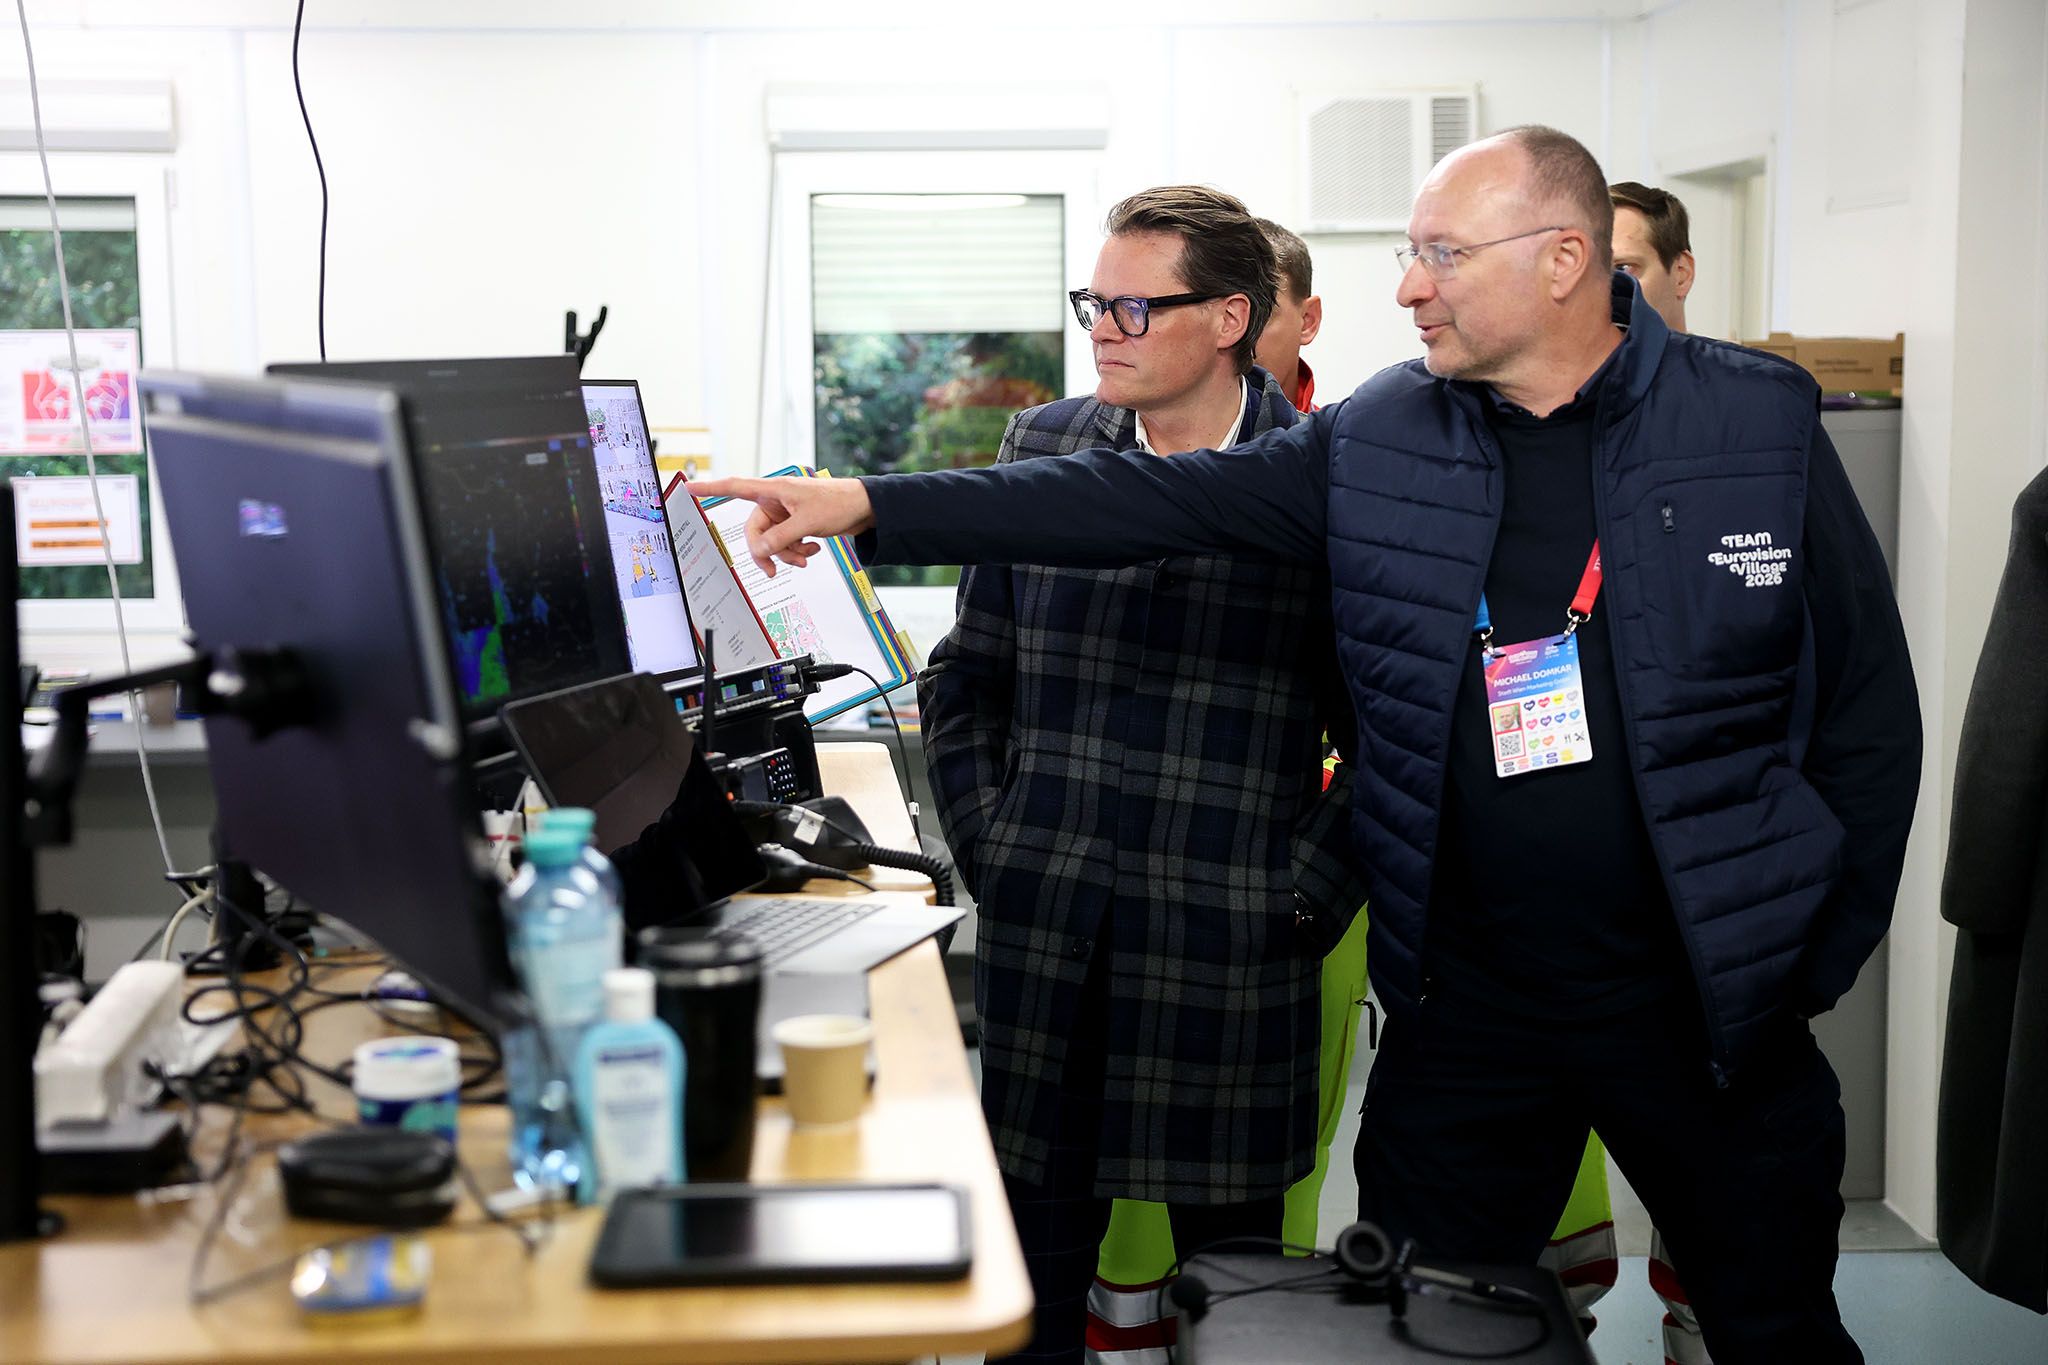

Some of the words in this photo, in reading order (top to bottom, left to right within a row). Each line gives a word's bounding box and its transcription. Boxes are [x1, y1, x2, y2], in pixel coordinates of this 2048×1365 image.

[1721, 532, 1772, 548] TEAM
[1708, 546, 1792, 566] Eurovision
[1729, 561, 1787, 576] Village
[1745, 572, 1783, 587] 2026
[1493, 673, 1533, 688] MICHAEL
[1533, 664, 1573, 680] DOMKAR
